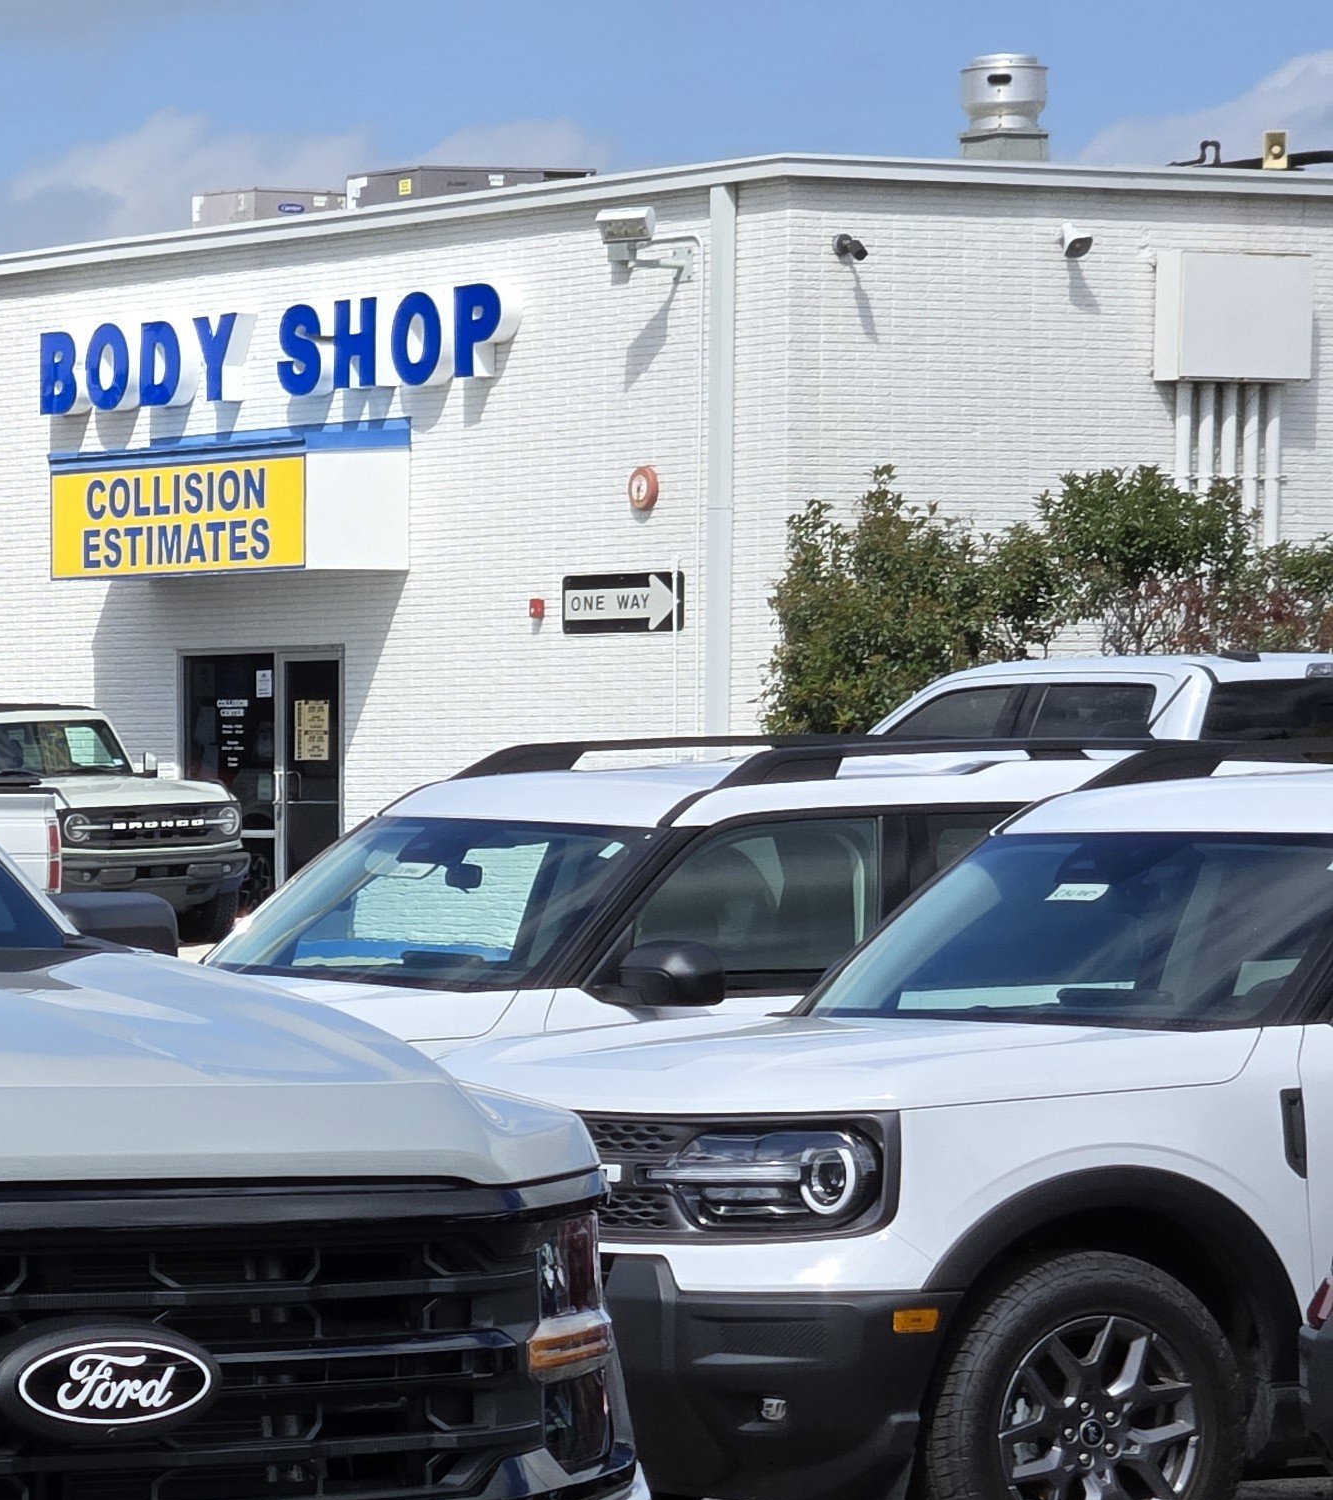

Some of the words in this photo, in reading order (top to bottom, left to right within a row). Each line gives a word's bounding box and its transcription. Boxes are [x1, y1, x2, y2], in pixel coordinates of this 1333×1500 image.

[40, 312, 237, 415] BODY
[277, 284, 501, 396] SHOP
[85, 467, 266, 521] COLLISION
[83, 518, 270, 568] ESTIMATES
[570, 595, 605, 611] ONE
[617, 593, 650, 610] WAY
[57, 1353, 176, 1410] Ford
